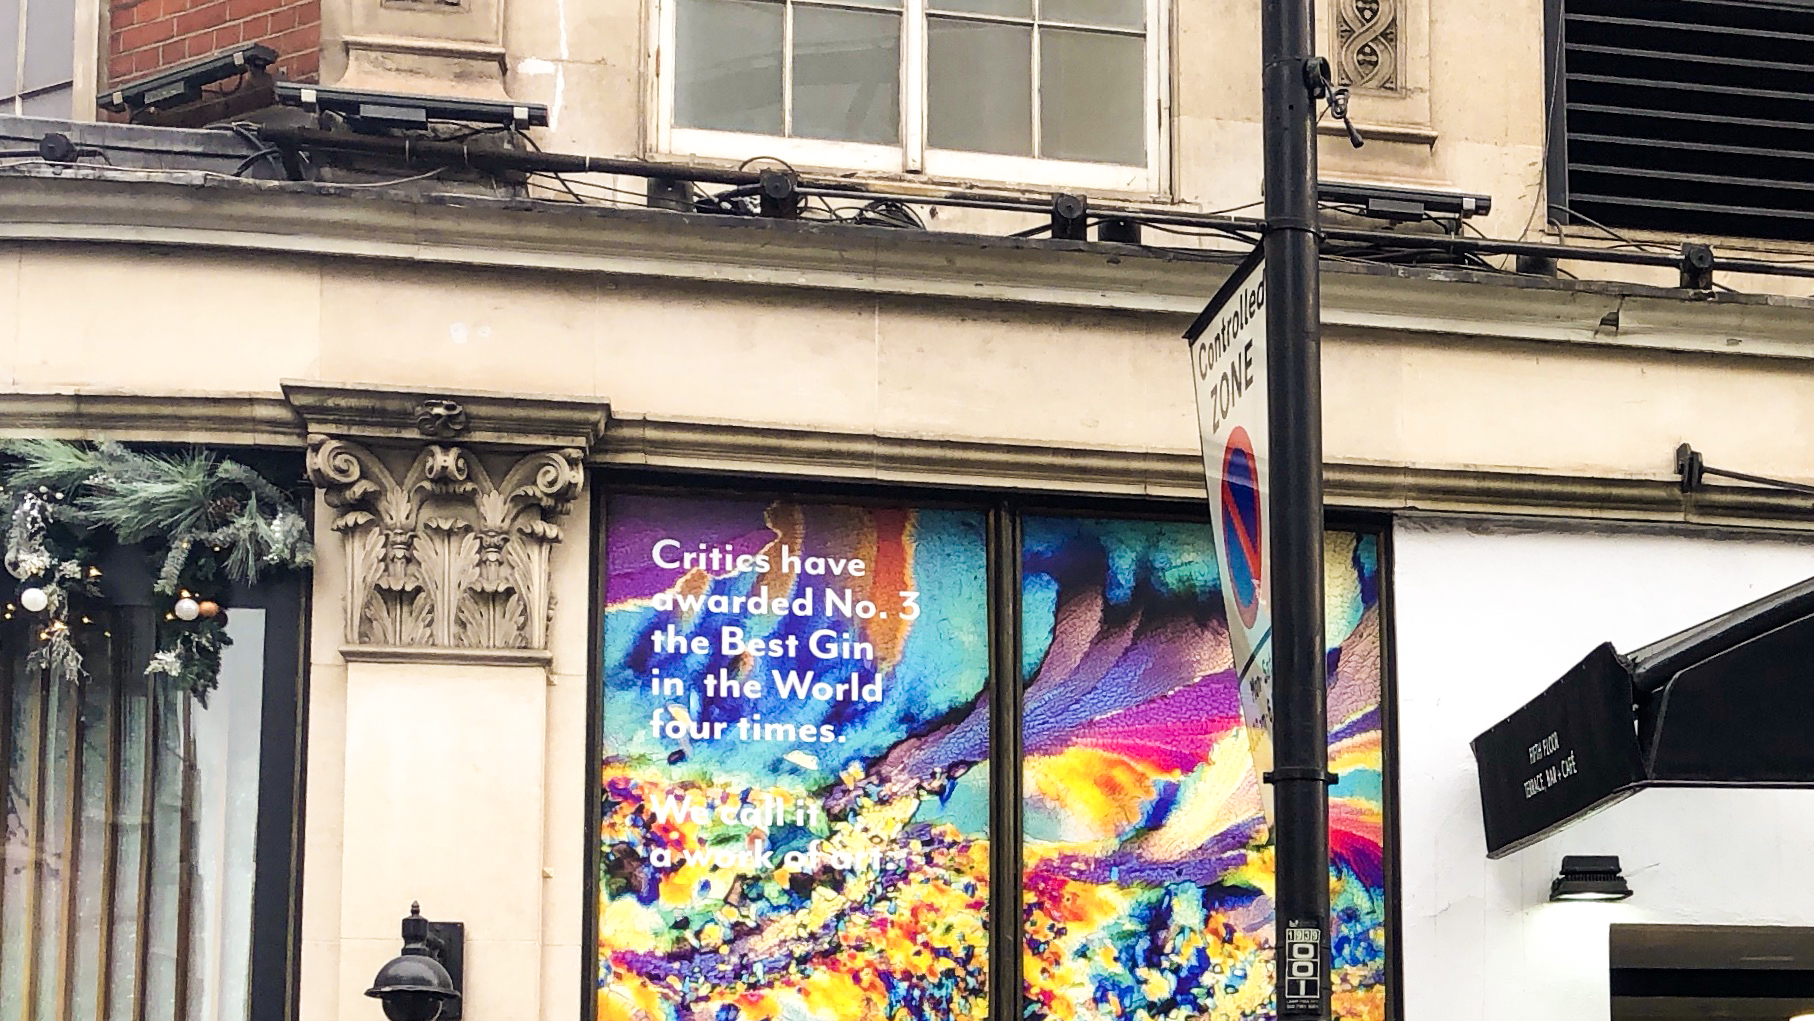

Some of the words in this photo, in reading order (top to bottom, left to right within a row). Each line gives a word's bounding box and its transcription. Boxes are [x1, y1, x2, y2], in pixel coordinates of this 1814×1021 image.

[1198, 268, 1265, 381] Controlled
[1210, 338, 1254, 434] ZONE
[652, 539, 770, 574] Critics
[781, 545, 866, 577] have
[652, 587, 813, 616] awarded
[825, 588, 887, 620] No.
[898, 591, 921, 621] 3
[651, 624, 709, 655] the
[721, 626, 799, 659] Best
[809, 629, 874, 661] Gin
[651, 668, 684, 697] in
[704, 669, 762, 699] the
[772, 671, 884, 703] World
[650, 711, 728, 740] four
[738, 714, 846, 744] times.
[650, 795, 710, 825] We
[720, 796, 784, 826] call
[796, 799, 819, 827] it
[649, 849, 672, 868] a
[683, 840, 774, 869] work
[784, 840, 818, 872] of
